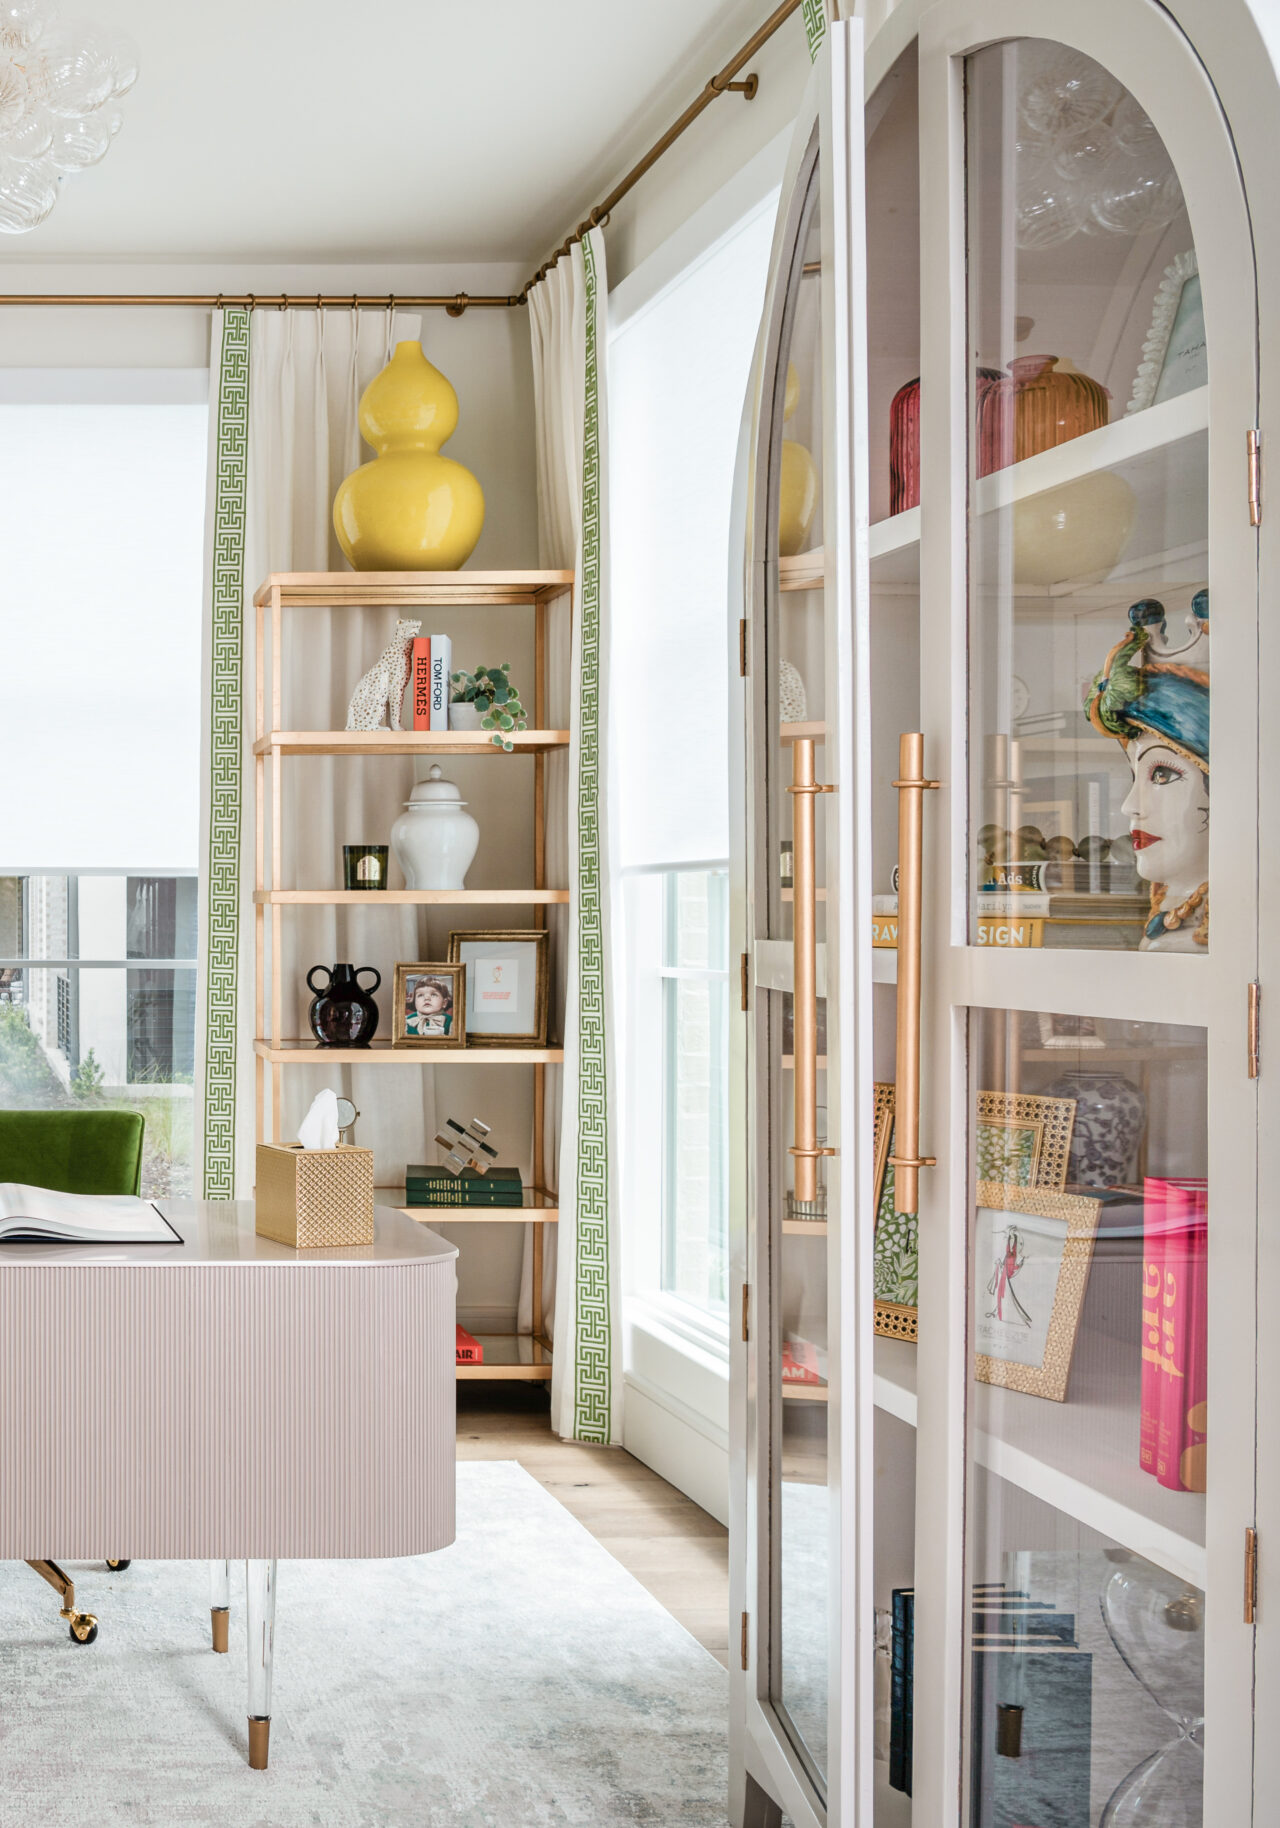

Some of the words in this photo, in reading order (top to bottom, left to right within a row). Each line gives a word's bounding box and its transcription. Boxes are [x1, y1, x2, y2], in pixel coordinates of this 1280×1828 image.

[433, 657, 443, 680] TOM
[433, 682, 442, 711] FORD
[998, 871, 1023, 885] Ads
[1142, 1259, 1162, 1372] art
[1161, 1266, 1184, 1383] art
